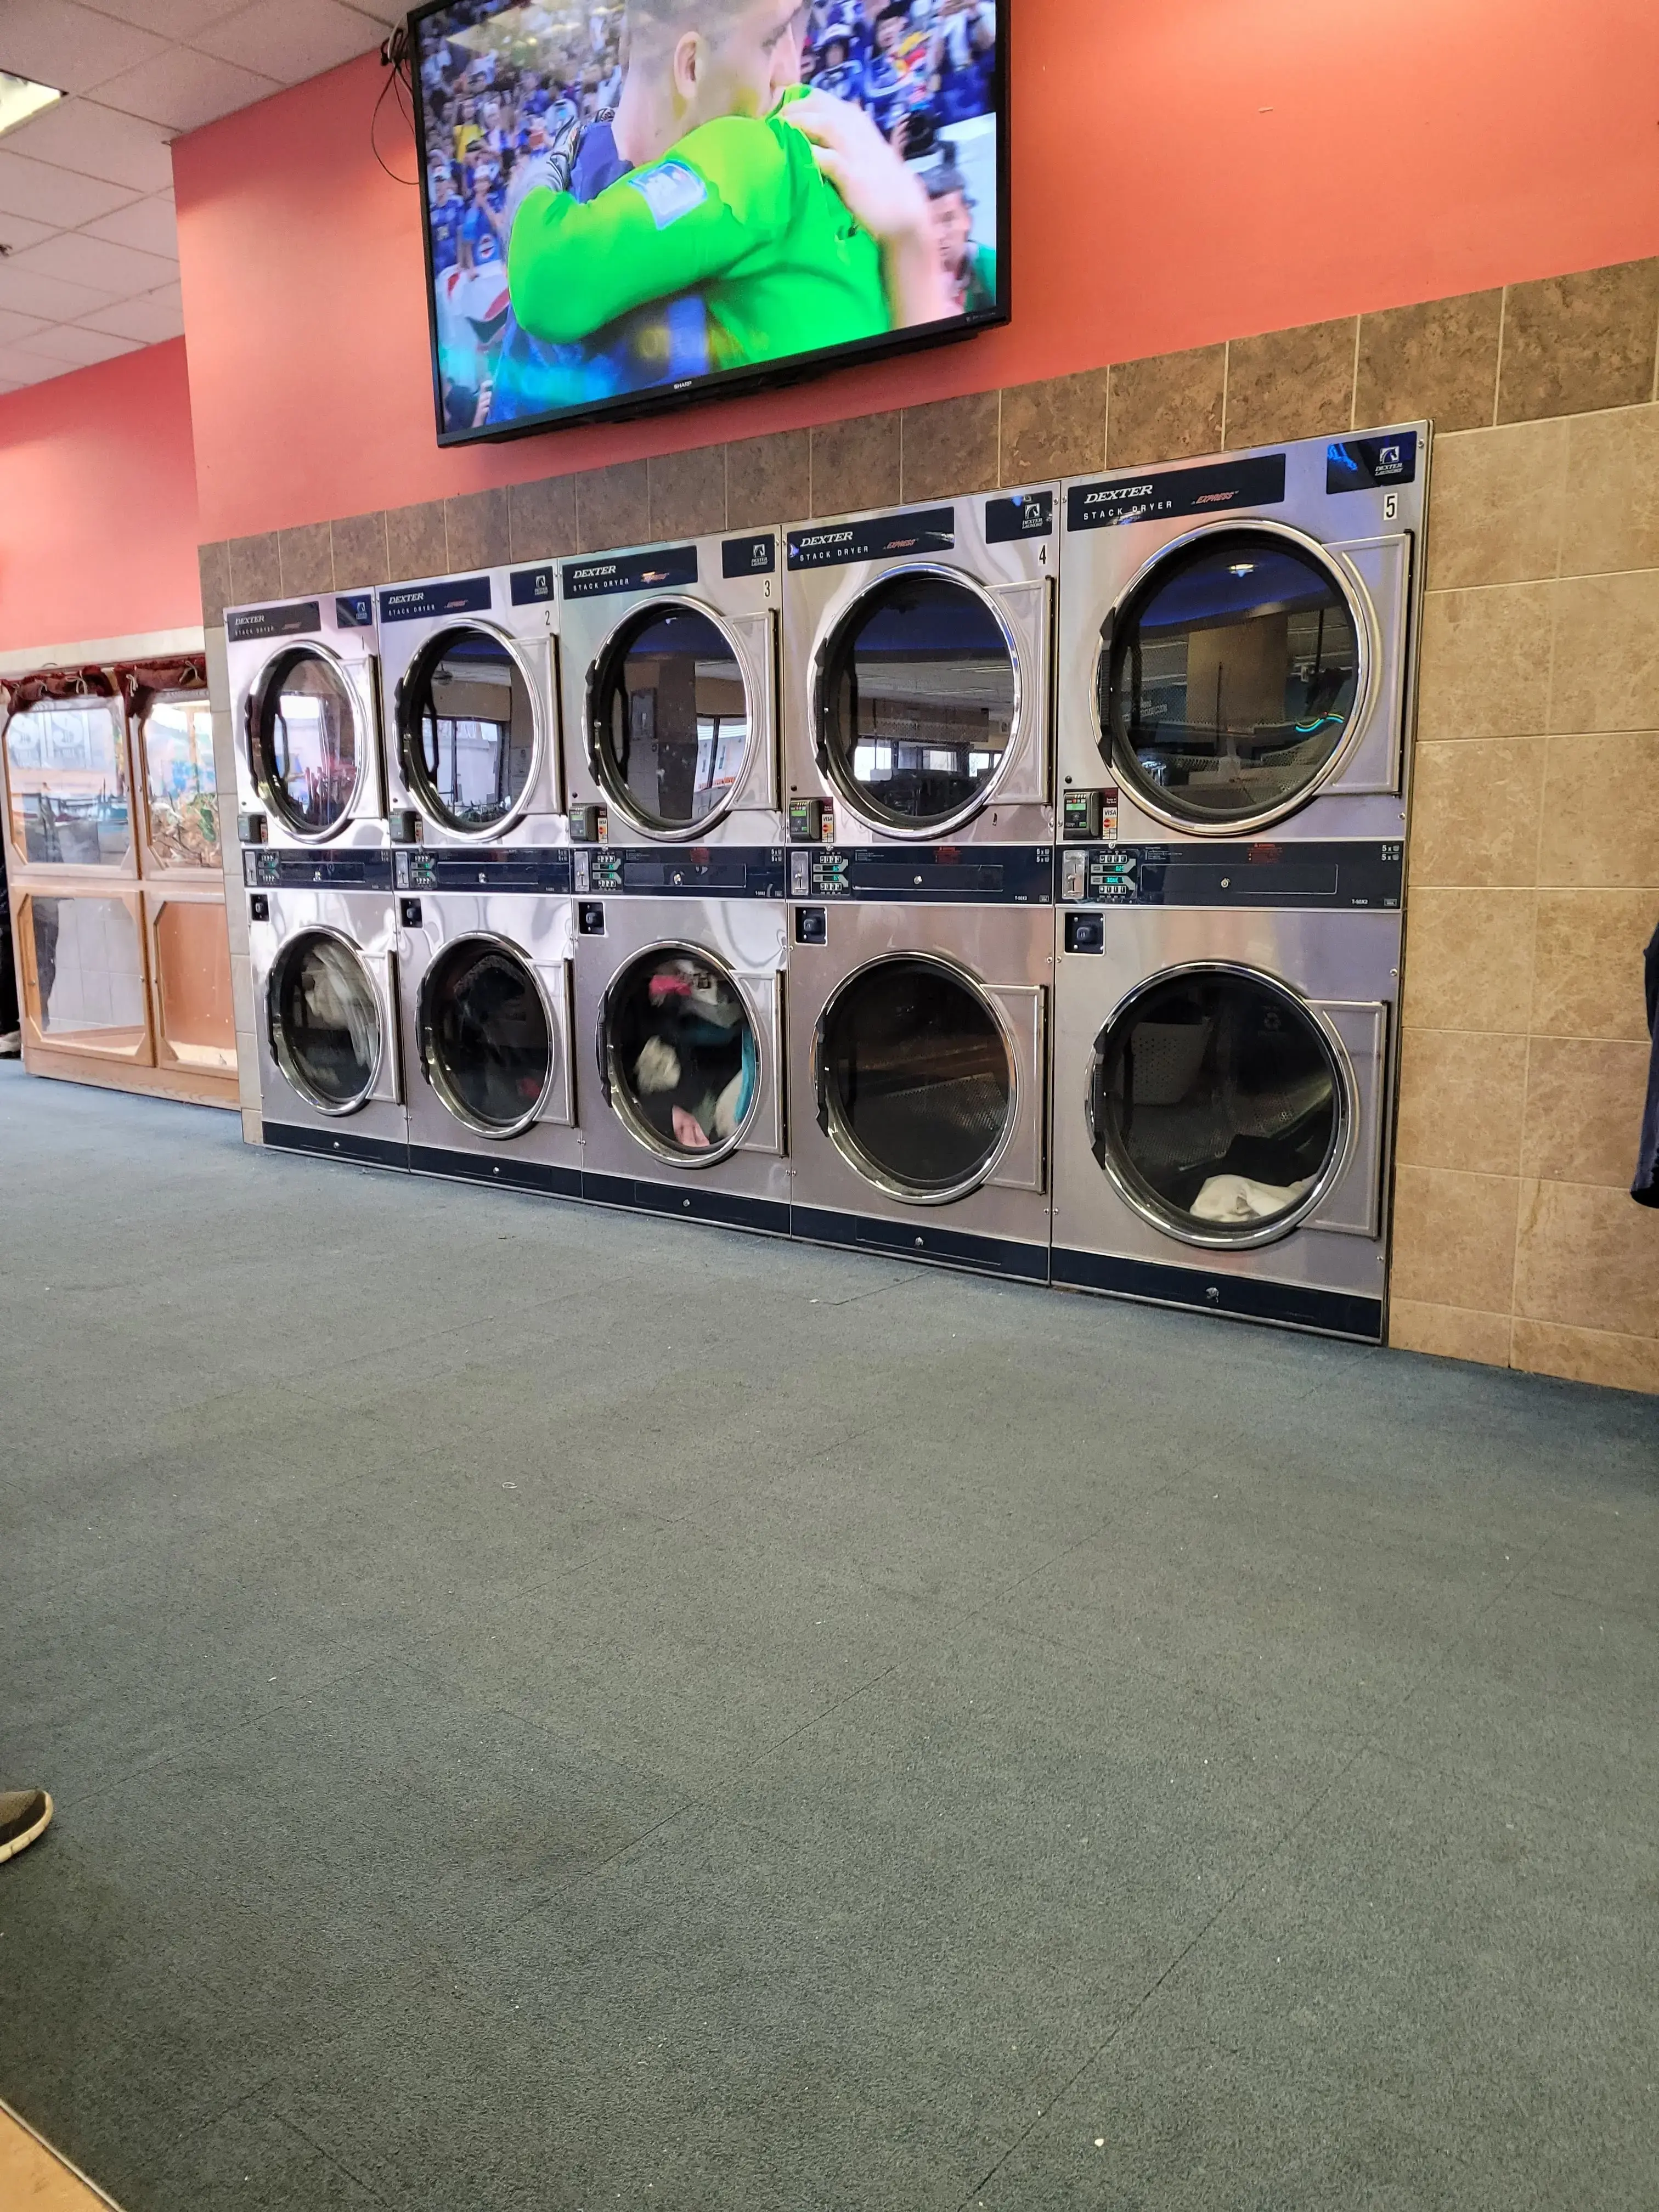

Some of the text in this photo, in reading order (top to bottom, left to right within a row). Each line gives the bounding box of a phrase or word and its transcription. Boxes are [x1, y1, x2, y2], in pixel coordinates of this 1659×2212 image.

[1375, 462, 1403, 472] DEXTER
[1084, 484, 1153, 504] DEXTER
[1195, 491, 1234, 504] EXPRESS
[1084, 500, 1172, 521] STACK DRYER
[1386, 495, 1395, 518] 5
[1022, 517, 1043, 526] DEXTER
[800, 531, 853, 547] DEXTER
[800, 545, 868, 561] STACK DRYER
[1039, 544, 1047, 565] 4
[573, 565, 616, 579] DEXTER
[573, 578, 629, 591] STACK DRYER
[764, 580, 770, 597] 3
[388, 592, 424, 605] DEXTER
[388, 607, 410, 617] STACK
[414, 603, 435, 613] DRYER
[234, 614, 265, 625] DEXTER
[545, 610, 550, 625] 2
